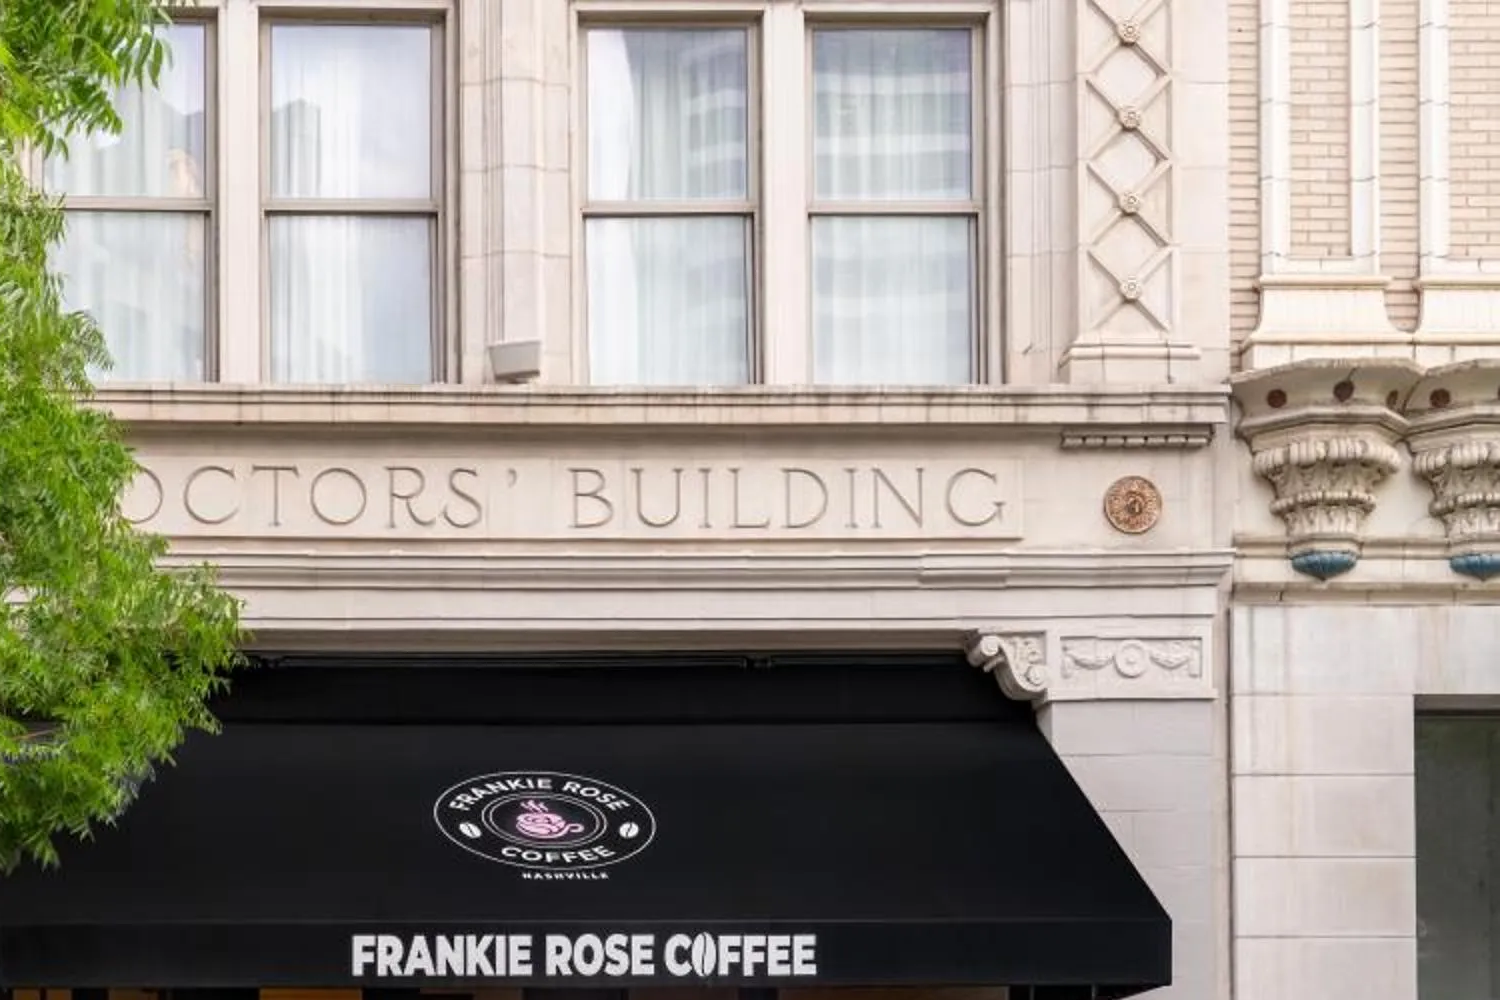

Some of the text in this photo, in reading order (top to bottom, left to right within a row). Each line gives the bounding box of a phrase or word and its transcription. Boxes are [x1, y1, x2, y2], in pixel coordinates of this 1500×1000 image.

[114, 464, 1007, 530] OCTORS' BUILDING
[449, 777, 631, 812] FRANKIE ROSE
[501, 845, 616, 864] COFFEE
[521, 871, 610, 881] NASHVILLE
[351, 931, 818, 978] FRANKIE ROSE COFFEE
